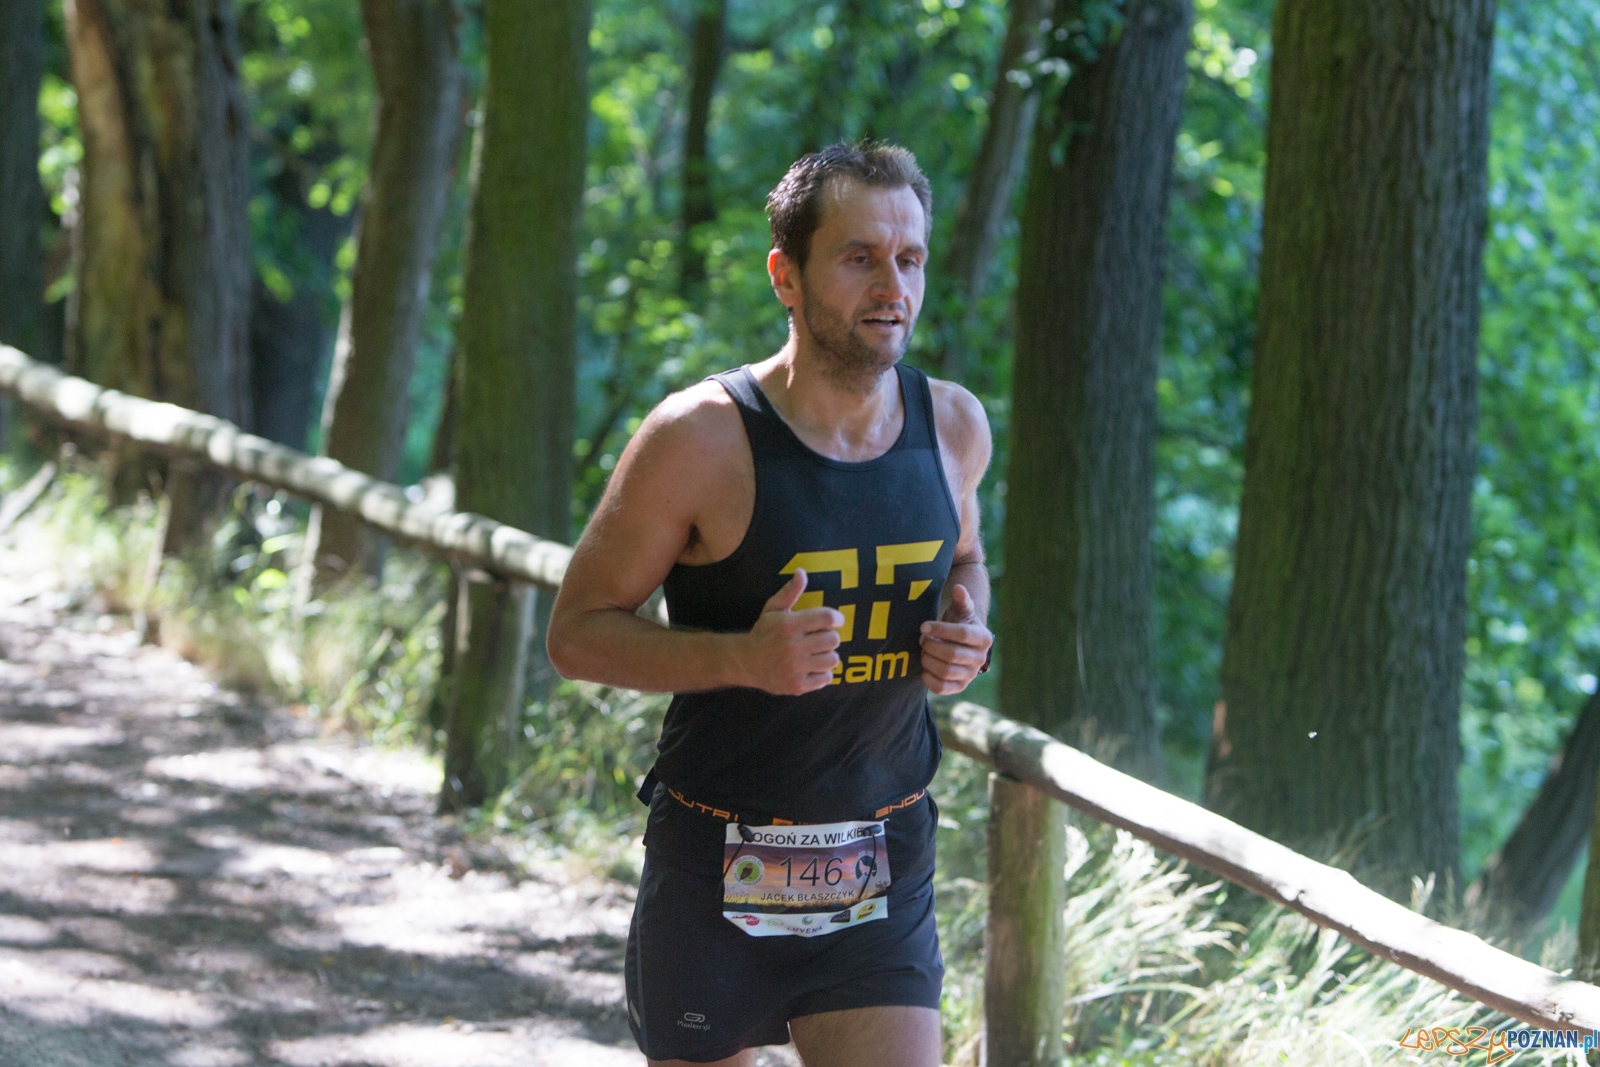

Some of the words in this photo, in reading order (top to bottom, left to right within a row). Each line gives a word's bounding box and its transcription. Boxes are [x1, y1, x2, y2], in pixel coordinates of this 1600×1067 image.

[752, 832, 797, 846] OGOŃ
[801, 834, 821, 846] ZA
[824, 827, 873, 845] WILKIE
[780, 856, 844, 887] 146
[760, 892, 795, 903] JACEK
[797, 890, 856, 902] BŁASZCZYK
